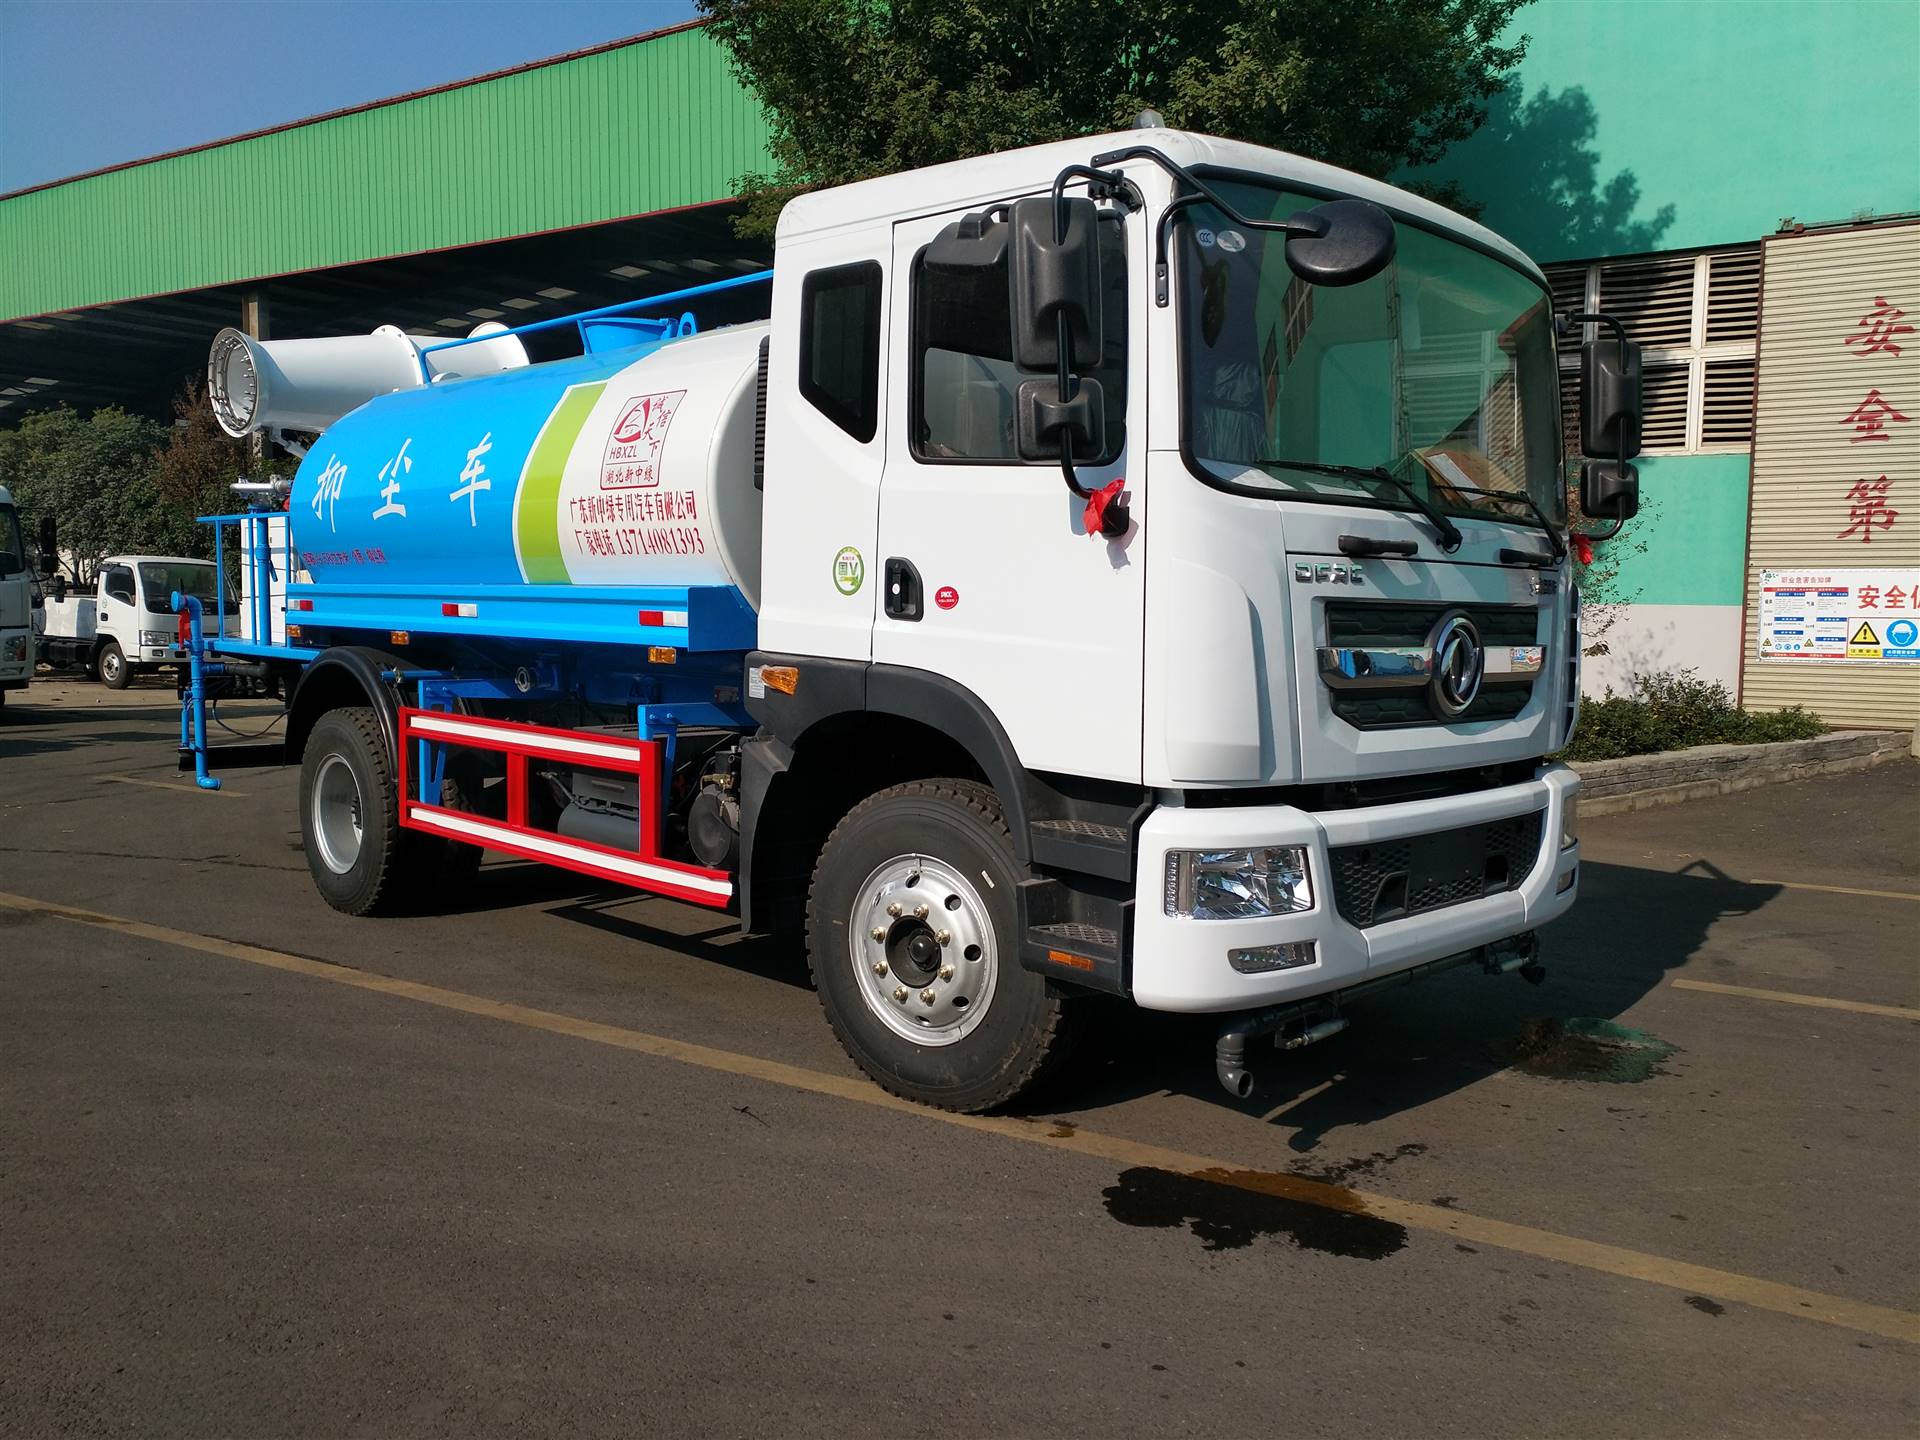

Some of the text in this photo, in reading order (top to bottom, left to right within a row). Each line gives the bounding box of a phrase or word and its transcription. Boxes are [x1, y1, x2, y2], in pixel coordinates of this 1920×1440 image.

[641, 396, 672, 458] 诚信天下
[609, 445, 637, 460] HBXZL
[605, 464, 654, 484] 湖北新中绿
[569, 489, 698, 525] 广东新中绿专用汽车有限公司
[575, 527, 705, 556] 厂家电话 13714081393
